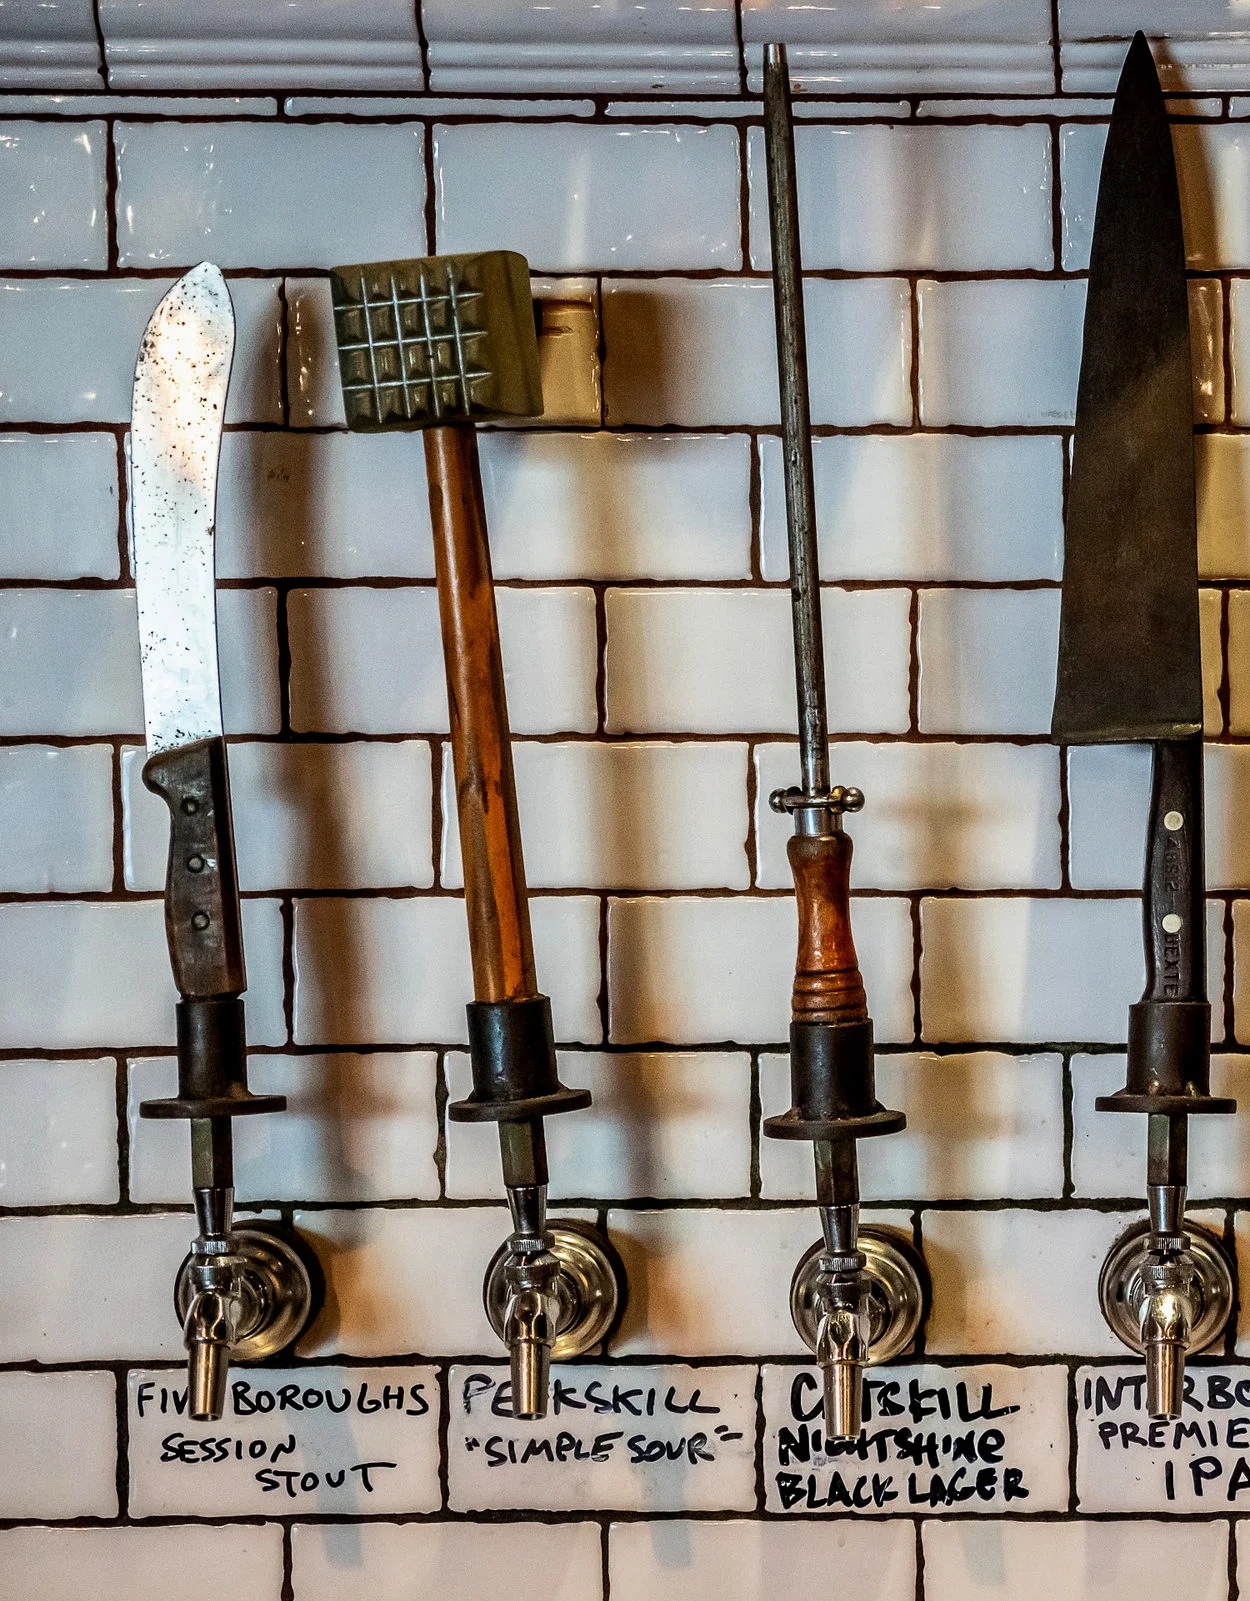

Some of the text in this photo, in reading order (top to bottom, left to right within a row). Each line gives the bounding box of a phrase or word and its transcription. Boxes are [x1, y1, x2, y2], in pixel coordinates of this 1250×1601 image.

[231, 1380, 430, 1416] BOROUGHS
[462, 1373, 720, 1417] PEKSKILL
[790, 1372, 1021, 1424] CTSKILL
[160, 1432, 297, 1463] SESSION
[255, 1462, 398, 1498] STOUT
[775, 1466, 1029, 1510] BLACK LAGER
